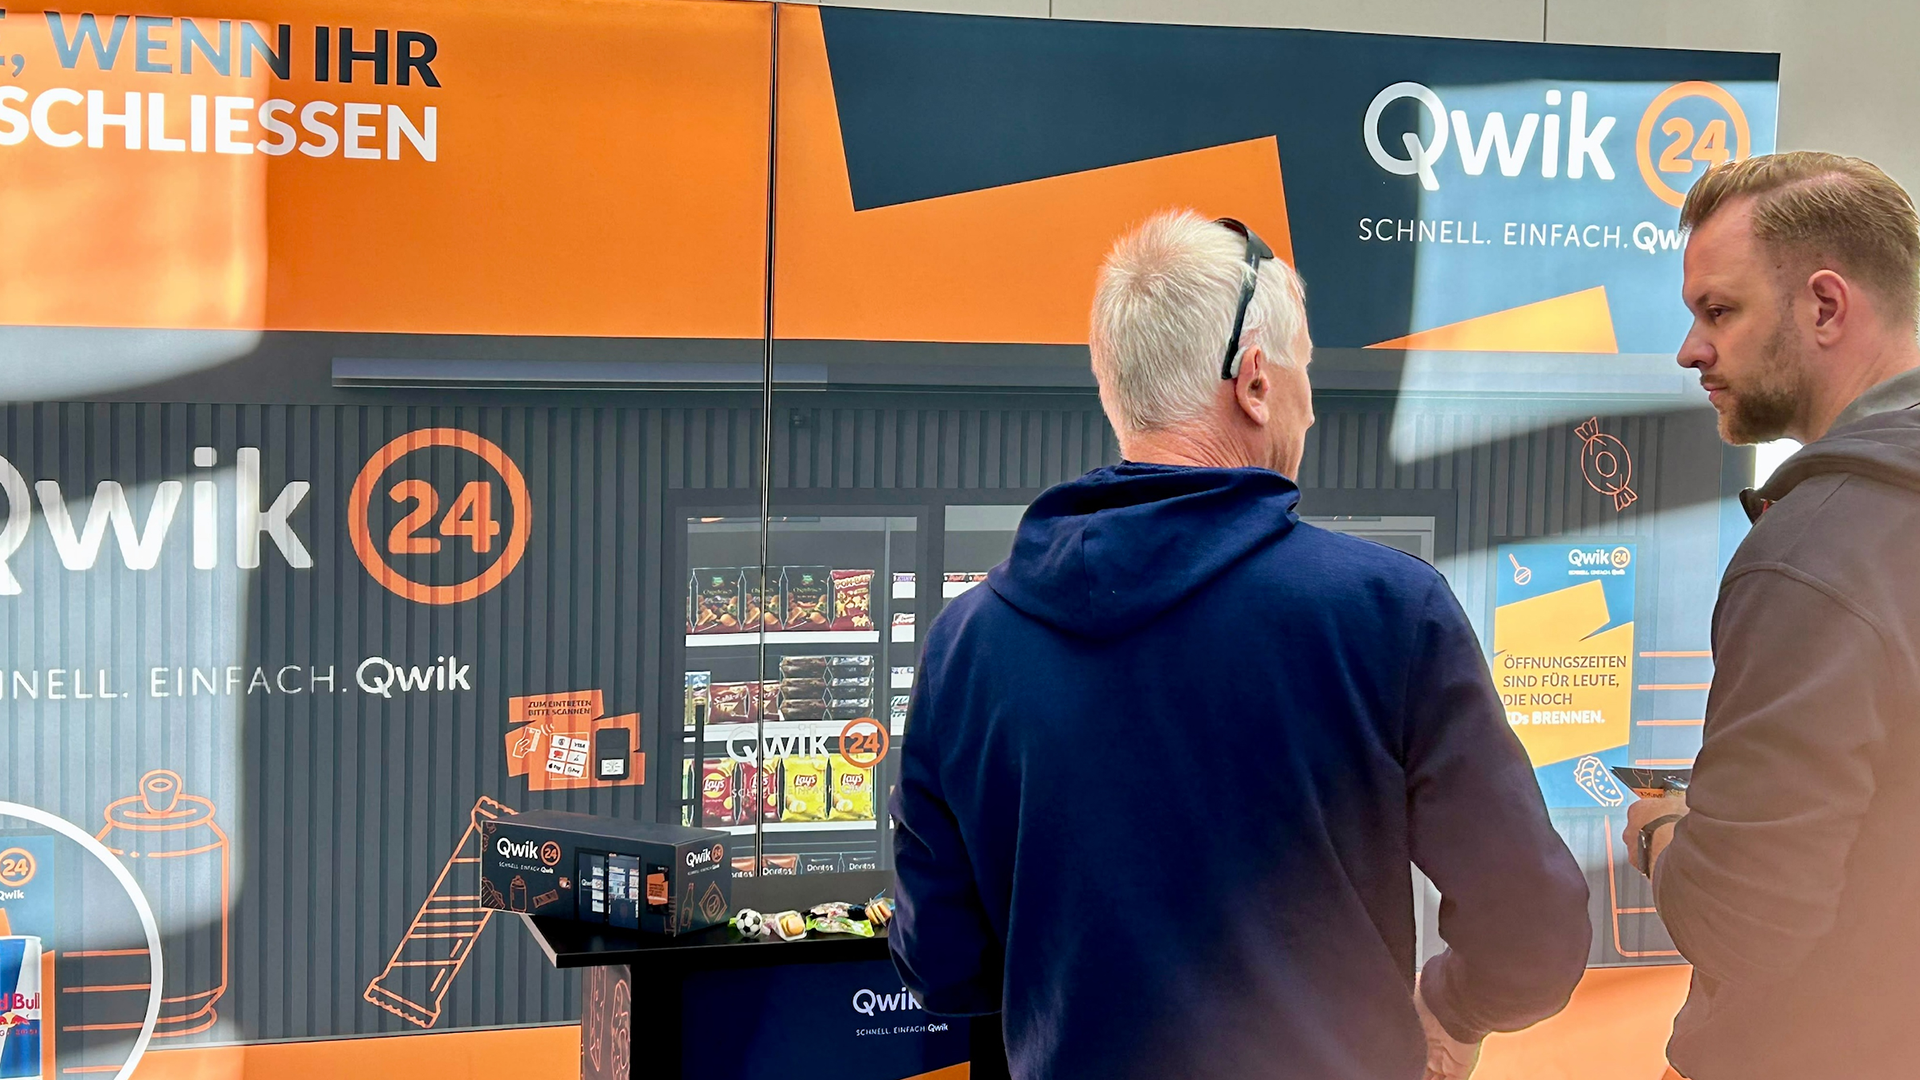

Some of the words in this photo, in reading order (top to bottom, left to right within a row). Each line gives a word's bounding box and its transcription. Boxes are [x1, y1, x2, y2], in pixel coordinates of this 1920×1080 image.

[44, 11, 291, 80] WENN
[315, 25, 442, 88] IHR
[0, 85, 438, 162] SCHLIESSEN
[1363, 81, 1617, 191] Qwik
[1657, 117, 1731, 173] 24
[1358, 217, 1492, 245] SCHNELL.
[0, 447, 314, 595] wik
[388, 479, 500, 554] 24
[1568, 548, 1610, 567] Qwik
[1503, 654, 1627, 670] ÖFFNUNGSZEITEN
[0, 668, 129, 700] NELL.
[356, 655, 472, 699] Qwik
[1503, 674, 1538, 688] SIND
[1541, 672, 1570, 687] FÜR
[1573, 674, 1620, 688] LEUTE,
[528, 701, 547, 709] ZUM
[548, 700, 592, 708] EINTRETEN
[1503, 693, 1527, 706] DIE
[1530, 692, 1573, 706] NOCH
[528, 708, 550, 717] BITTE
[1532, 709, 1606, 725] BRENNEN.
[726, 723, 831, 768] Qwik
[849, 731, 881, 754] 24
[496, 837, 539, 859] Qwik
[686, 847, 711, 868] Qwik
[2, 858, 29, 877] 24
[762, 866, 793, 877] Doritos
[12, 992, 40, 1010] Bull
